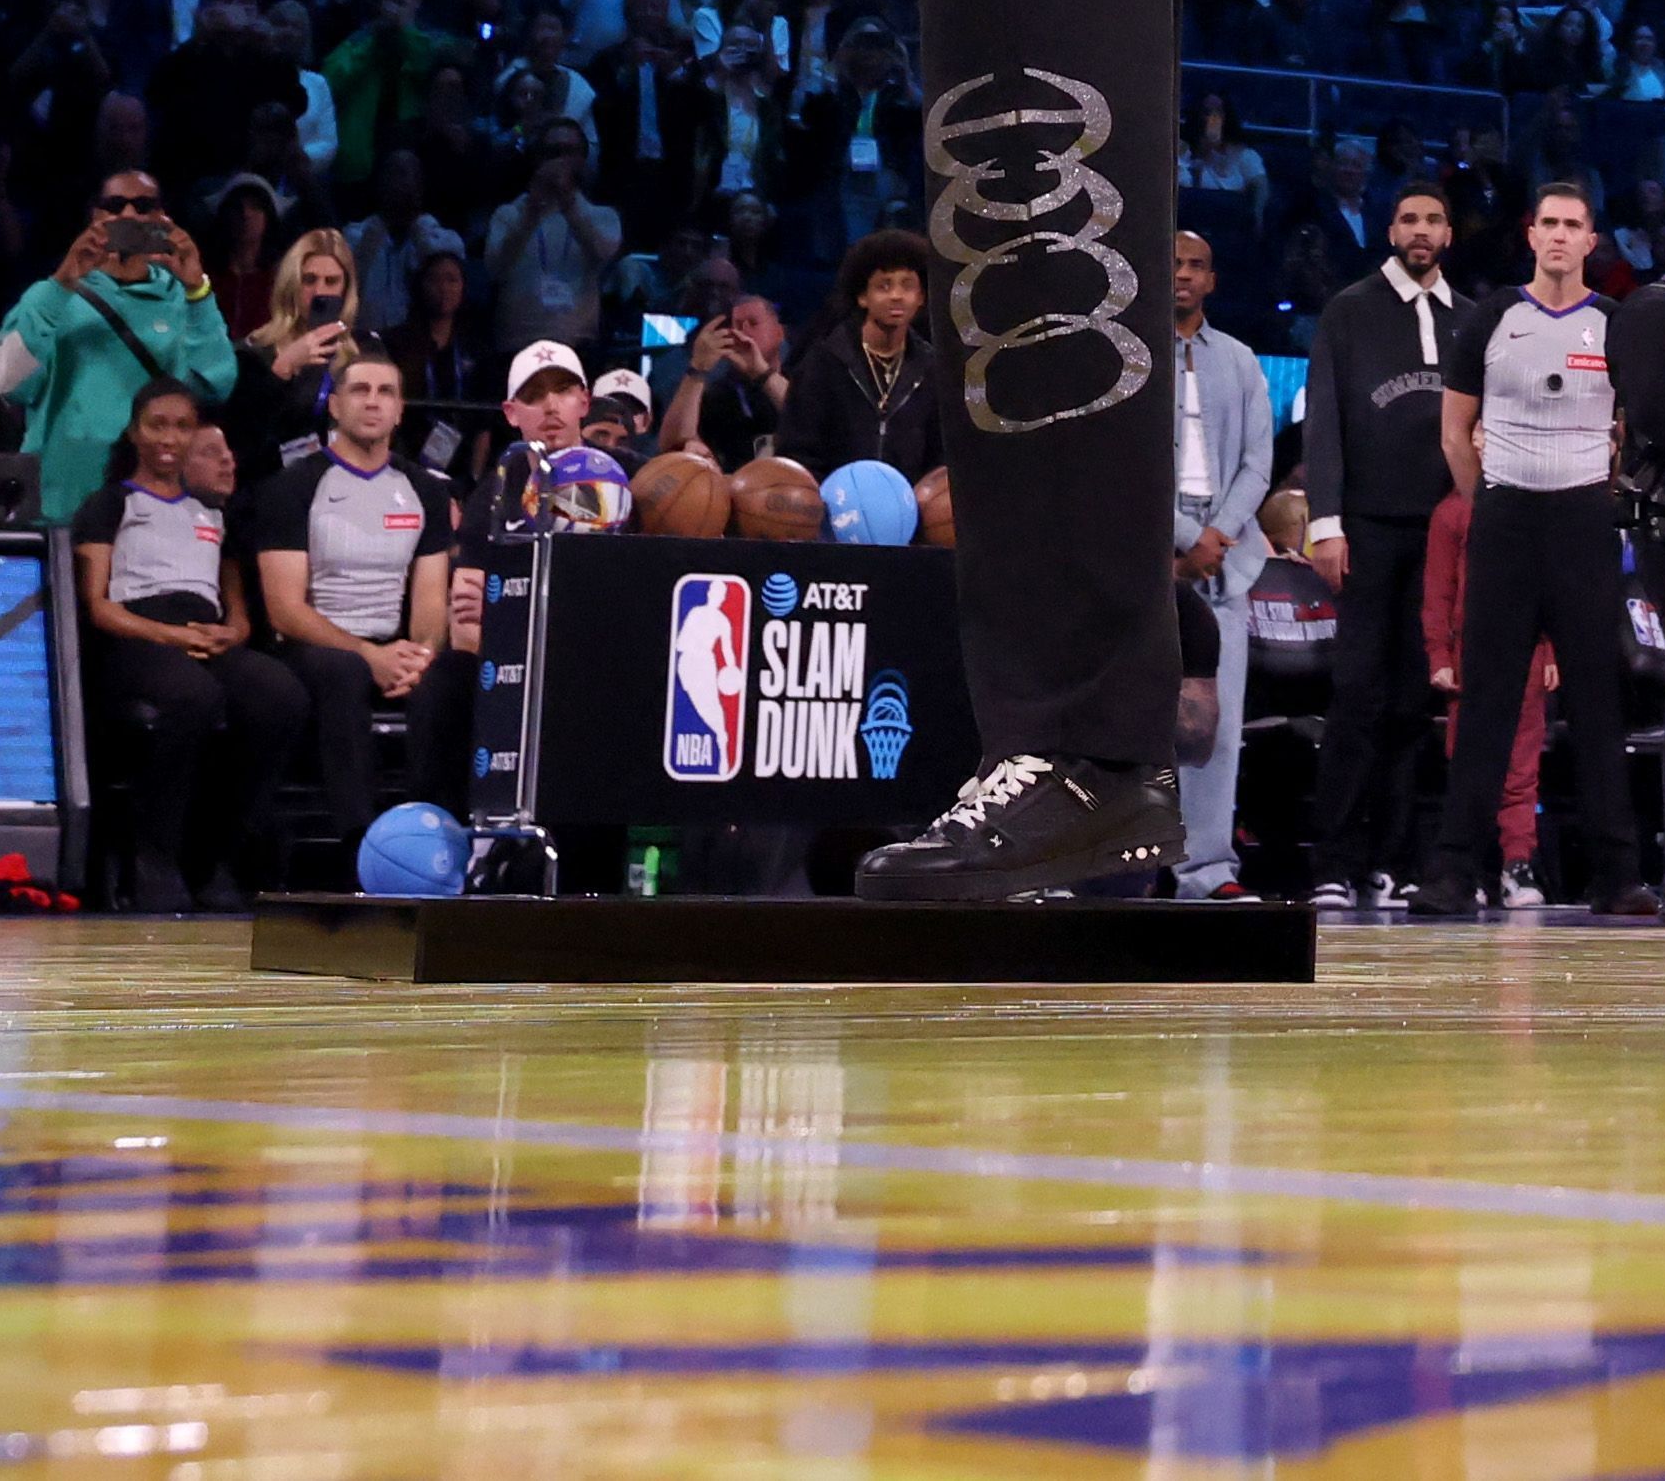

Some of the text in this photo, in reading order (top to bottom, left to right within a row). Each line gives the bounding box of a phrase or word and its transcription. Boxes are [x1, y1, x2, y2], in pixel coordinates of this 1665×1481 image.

[502, 576, 531, 598] AT&T
[801, 582, 868, 611] AT&T
[496, 663, 524, 685] AT&T
[759, 620, 866, 700] SLAM
[675, 732, 714, 768] NBA
[754, 700, 863, 779] DUNK
